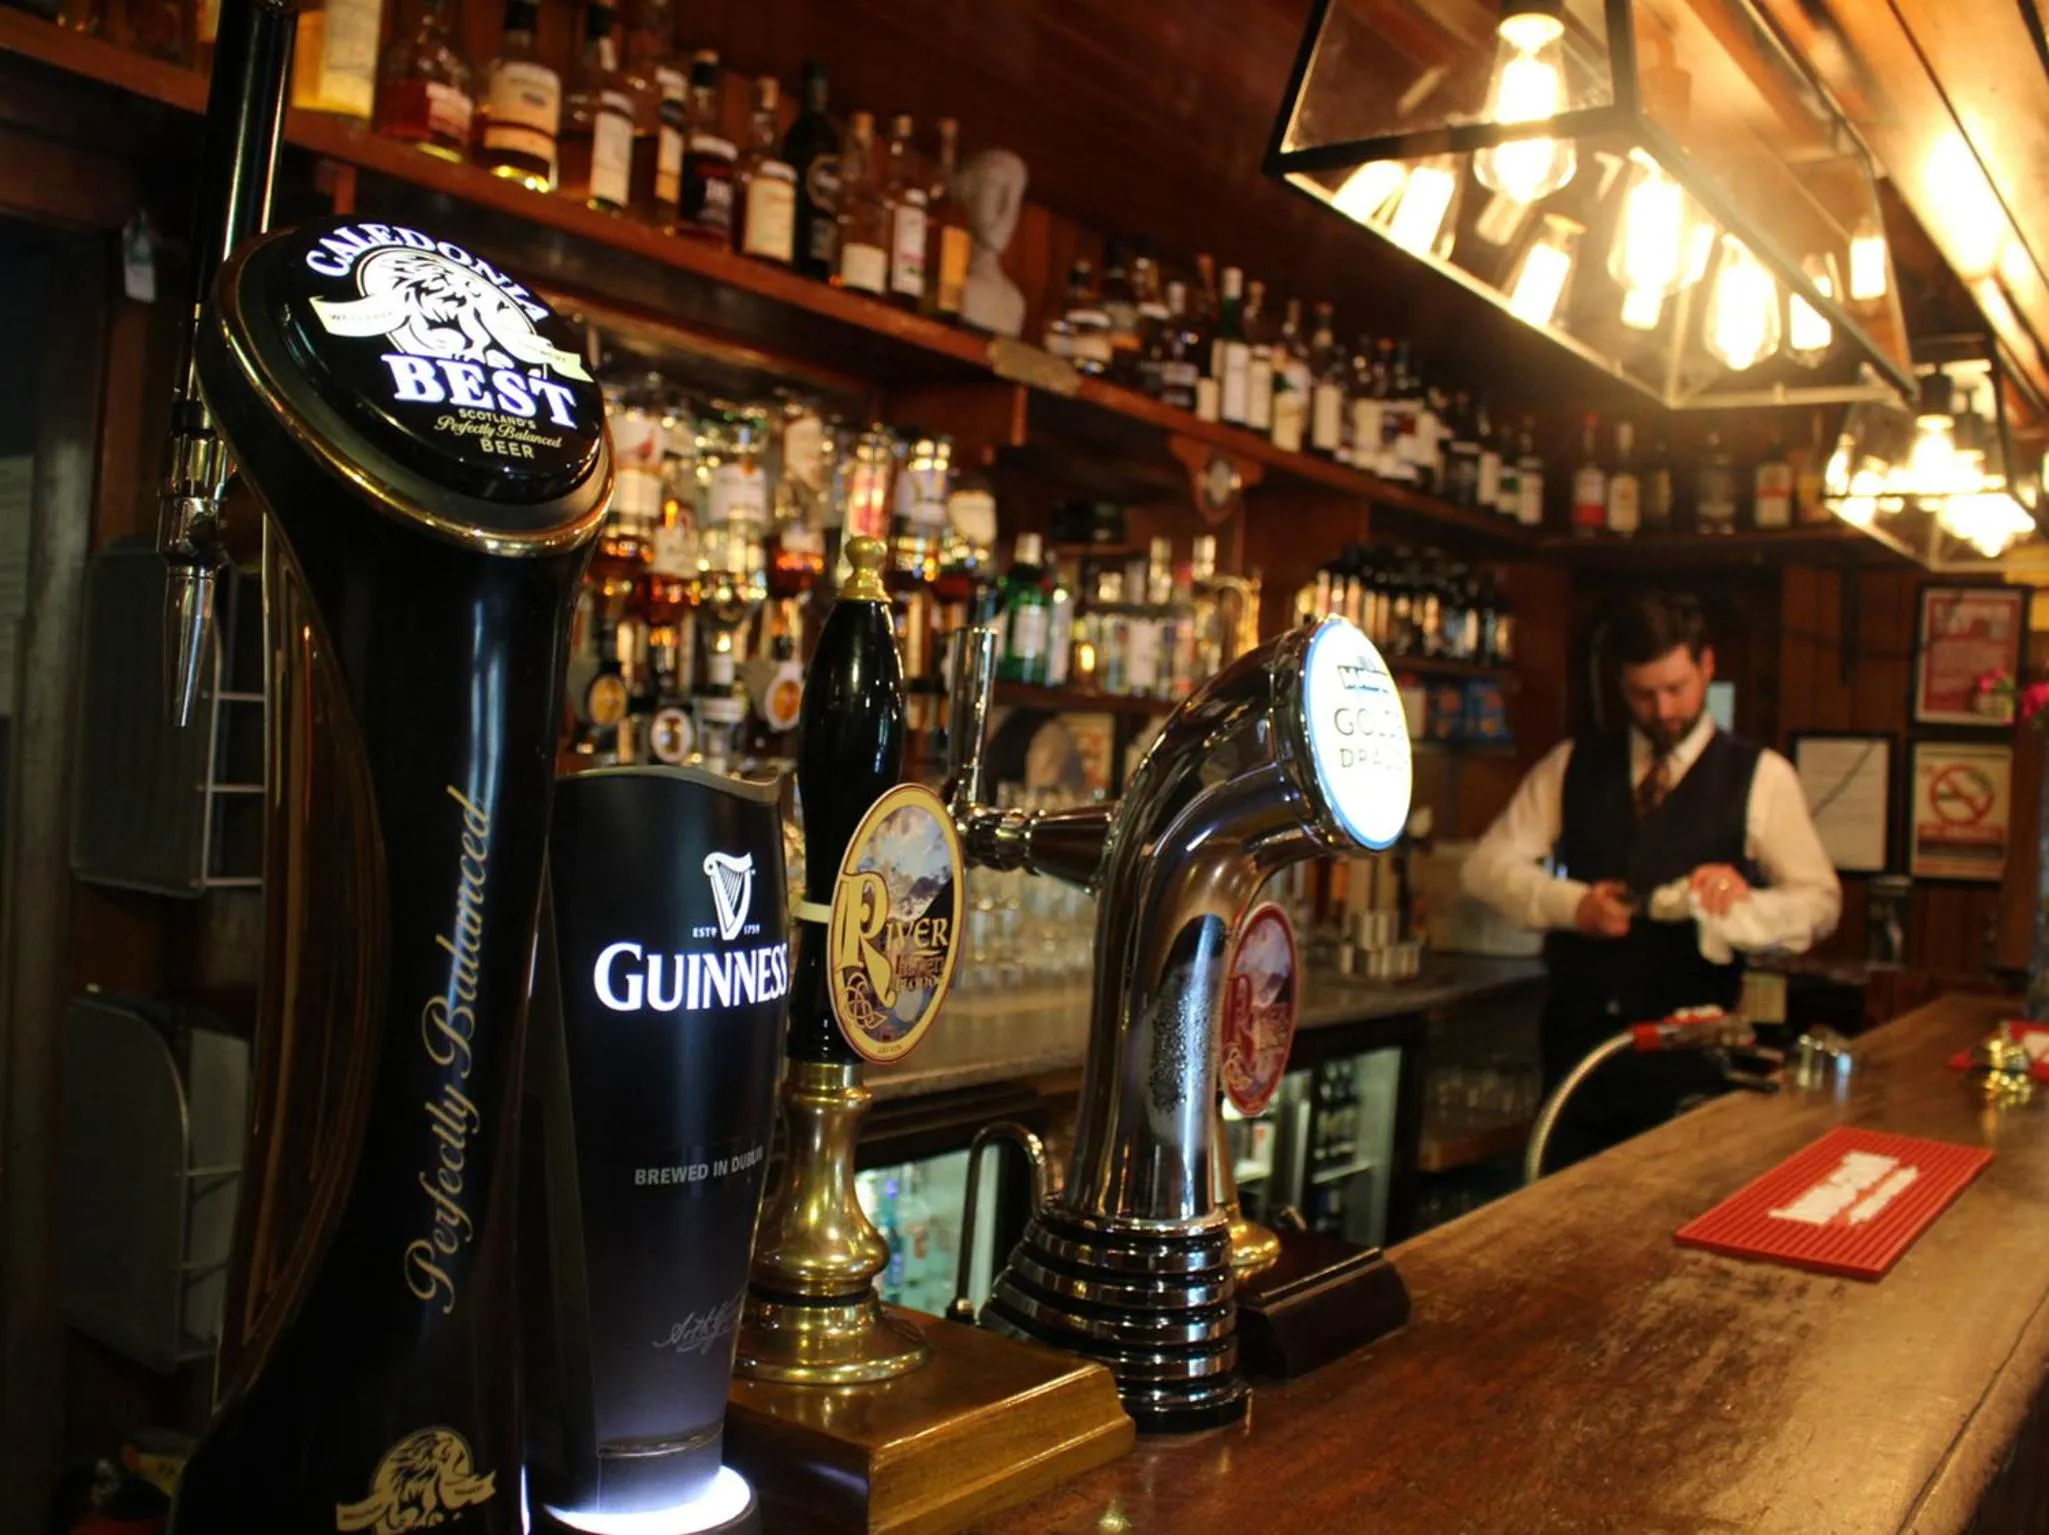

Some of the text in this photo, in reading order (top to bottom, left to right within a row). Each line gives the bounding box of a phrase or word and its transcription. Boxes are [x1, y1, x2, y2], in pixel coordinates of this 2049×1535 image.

[306, 223, 550, 322] CALEDONIA
[381, 354, 578, 429] BEST
[433, 415, 563, 449] Perfectly Balanced
[458, 407, 537, 430] SCOTLAND'S
[480, 438, 535, 459] BEER
[404, 784, 491, 1314] Perfectly Balanced
[634, 1162, 709, 1186] BREWED
[713, 1158, 728, 1178] IN
